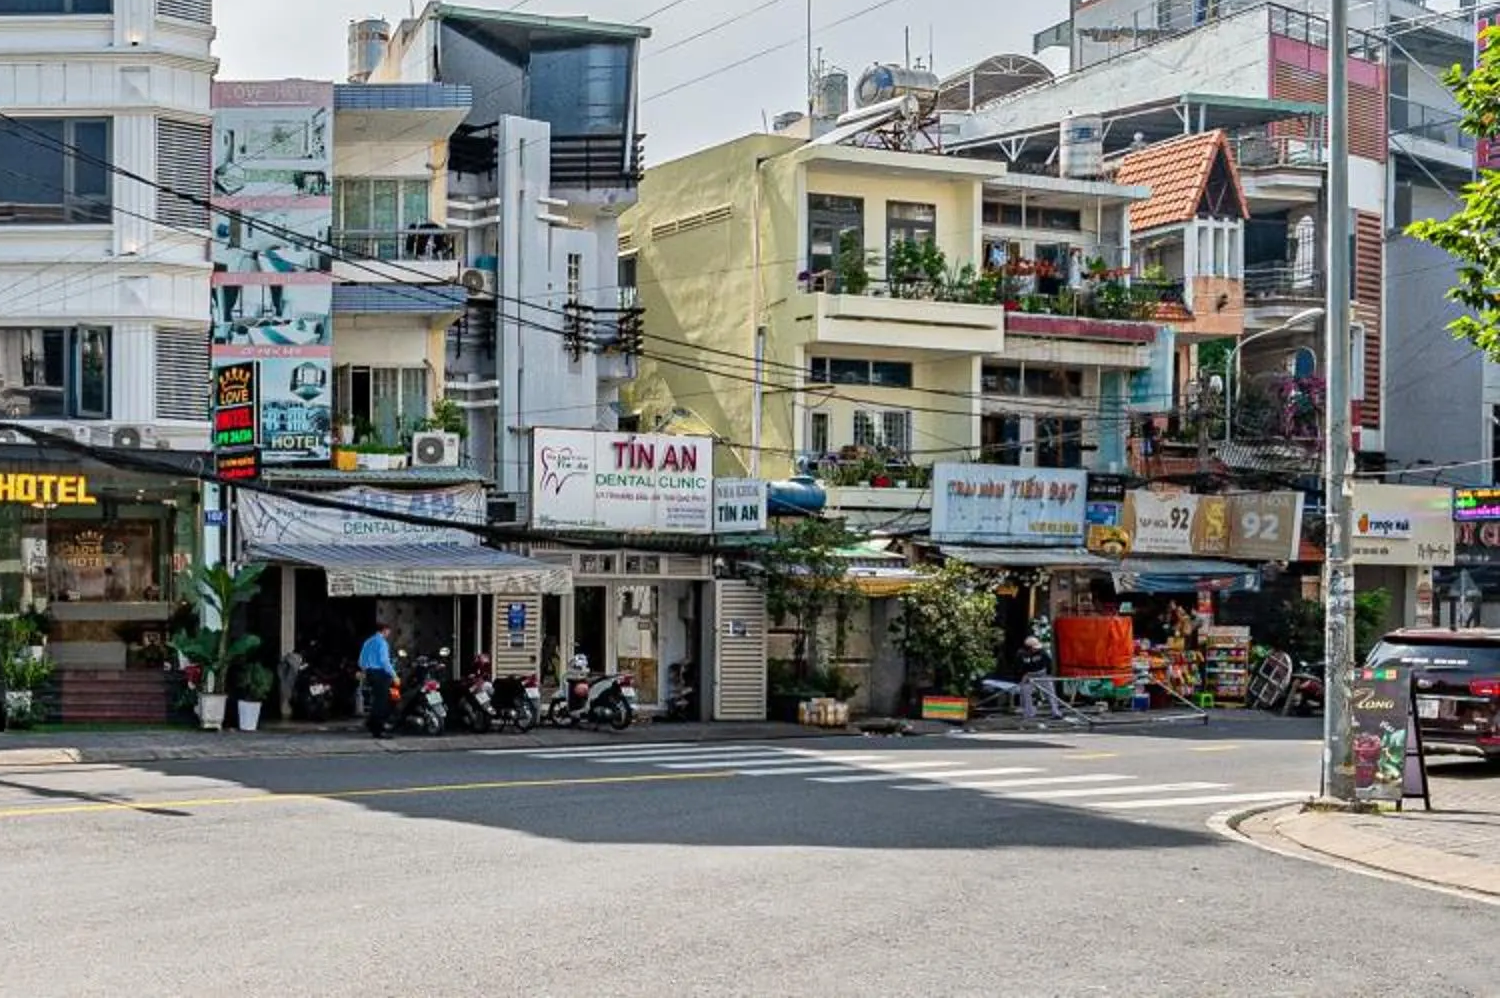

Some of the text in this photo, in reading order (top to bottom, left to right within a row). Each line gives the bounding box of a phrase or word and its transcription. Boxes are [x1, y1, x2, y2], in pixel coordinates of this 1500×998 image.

[221, 389, 249, 405] LOVE
[271, 435, 321, 449] HOTEL
[613, 436, 697, 473] TÍN AN
[595, 473, 707, 489] DENTAL CLINIC
[718, 502, 737, 522] TÍN
[741, 504, 759, 521] AN
[1170, 507, 1189, 530] 92
[1241, 513, 1279, 540] 92
